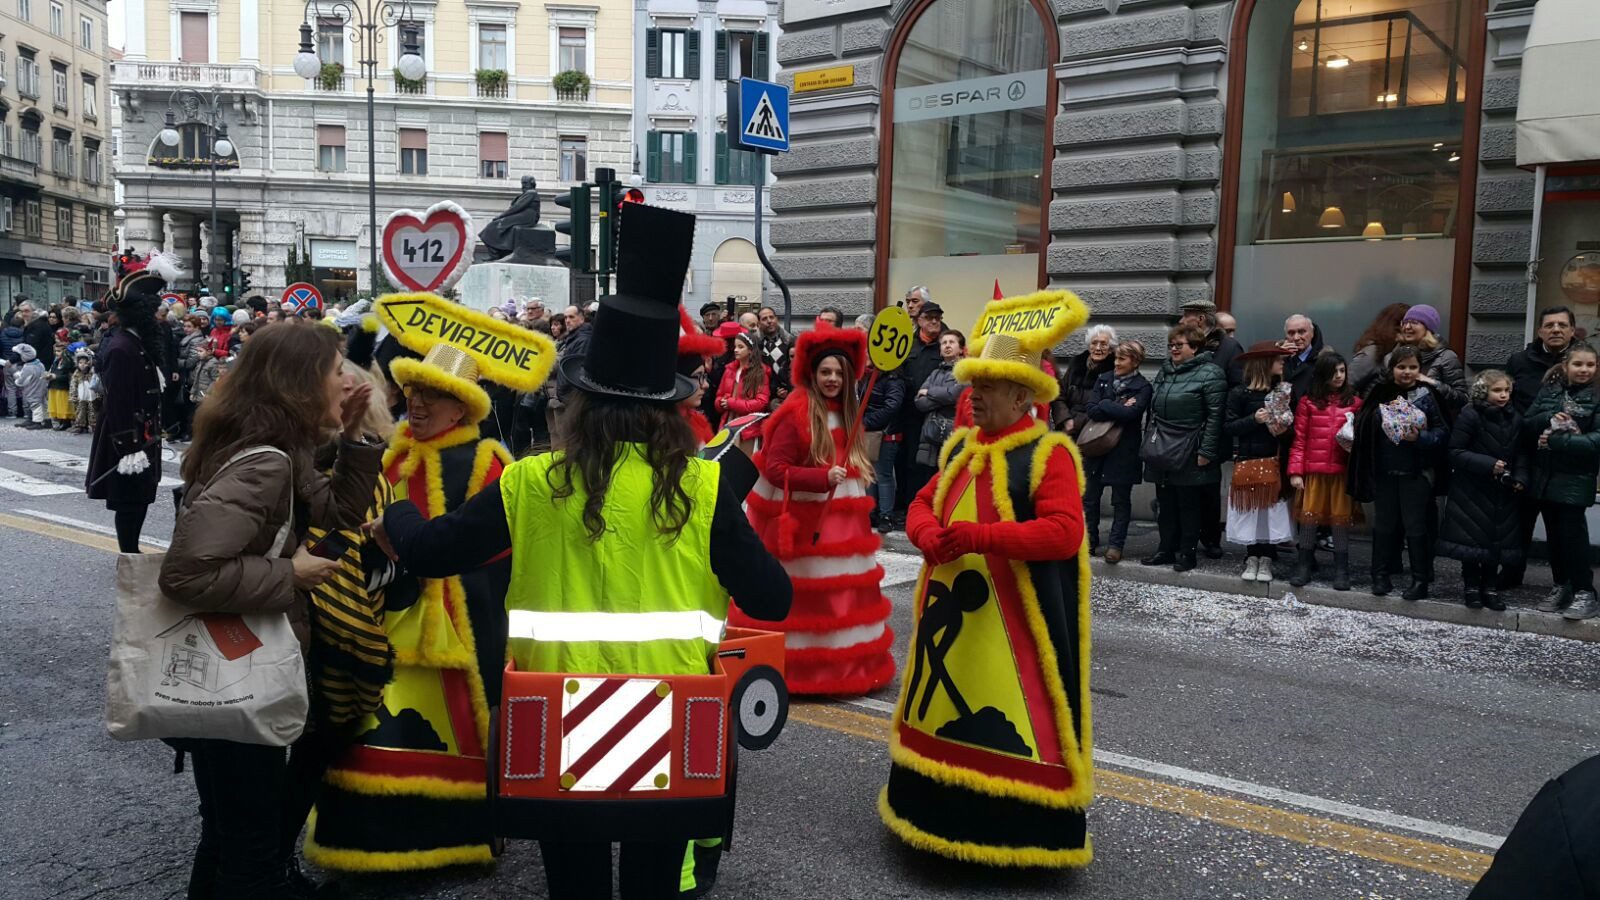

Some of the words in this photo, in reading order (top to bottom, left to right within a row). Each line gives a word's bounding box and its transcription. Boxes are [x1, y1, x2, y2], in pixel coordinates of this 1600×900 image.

[909, 87, 1001, 110] DESPAR
[403, 239, 444, 262] 412
[981, 306, 1061, 337] DEVIAZIONE
[406, 306, 539, 371] DEVIAZIONE
[872, 323, 909, 359] 530
[155, 691, 171, 700] even
[224, 694, 254, 705] watching
